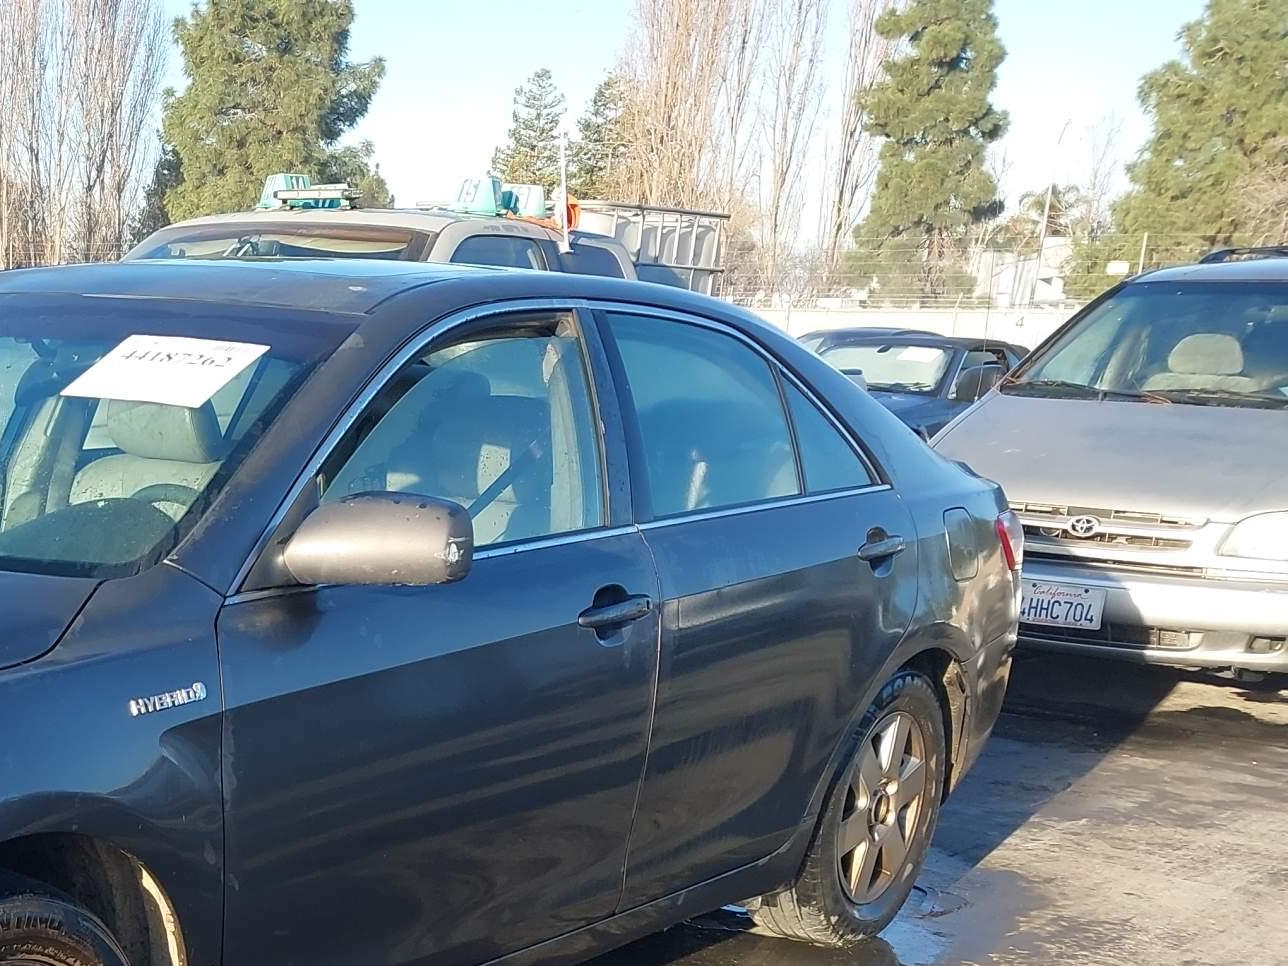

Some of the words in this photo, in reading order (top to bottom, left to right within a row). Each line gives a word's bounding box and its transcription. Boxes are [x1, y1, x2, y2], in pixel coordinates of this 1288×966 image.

[121, 350, 233, 367] 44187262
[1033, 585, 1089, 600] California
[129, 687, 195, 717] HYBRID
